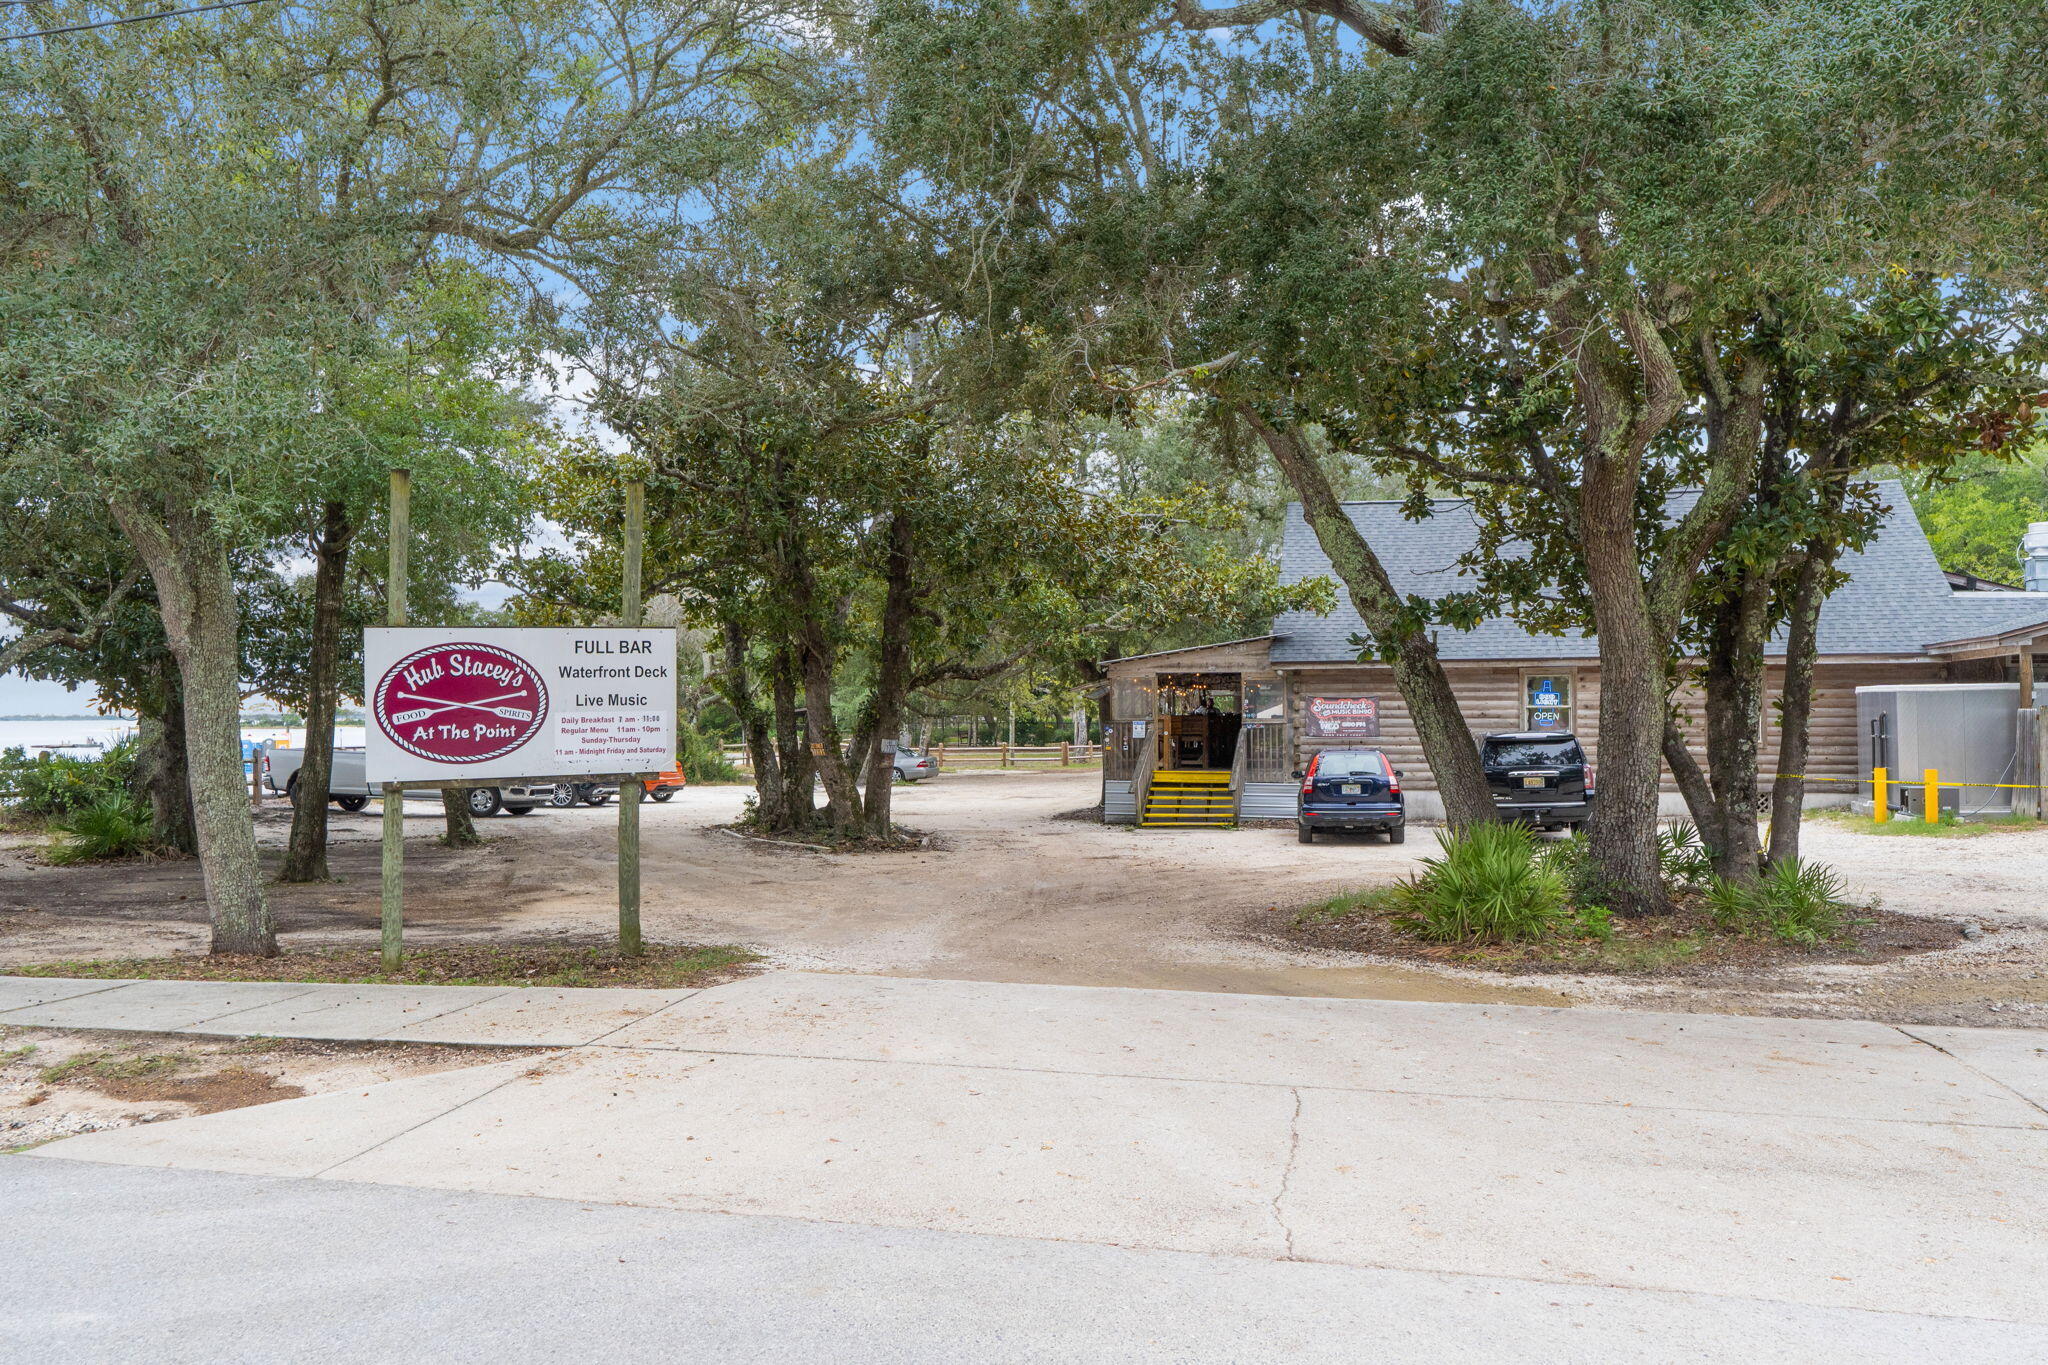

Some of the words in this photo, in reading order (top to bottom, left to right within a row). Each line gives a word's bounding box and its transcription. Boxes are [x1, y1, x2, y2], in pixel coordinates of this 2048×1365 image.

[575, 640, 614, 654] FULL
[620, 640, 652, 654] BAR
[403, 657, 444, 691] Hub
[450, 653, 525, 688] Stacey's
[558, 666, 631, 678] Waterfront
[634, 665, 668, 678] Deck
[576, 694, 604, 706] Live
[608, 693, 648, 706] Music
[1313, 700, 1367, 712] Soundcheck
[396, 710, 426, 722] FOOD
[498, 708, 531, 720] SPIRITS
[1534, 712, 1560, 720] OPEN
[561, 717, 579, 725] Daily
[581, 716, 615, 724] Breakfast
[412, 725, 435, 742] At
[438, 724, 470, 740] The
[474, 723, 517, 742] Point
[561, 727, 588, 735] Regular
[590, 726, 609, 734] Menu
[642, 725, 661, 733] 10pm
[581, 736, 641, 745] Sunday-Thursday
[579, 748, 605, 756] Midnight
[607, 747, 625, 755] Friday
